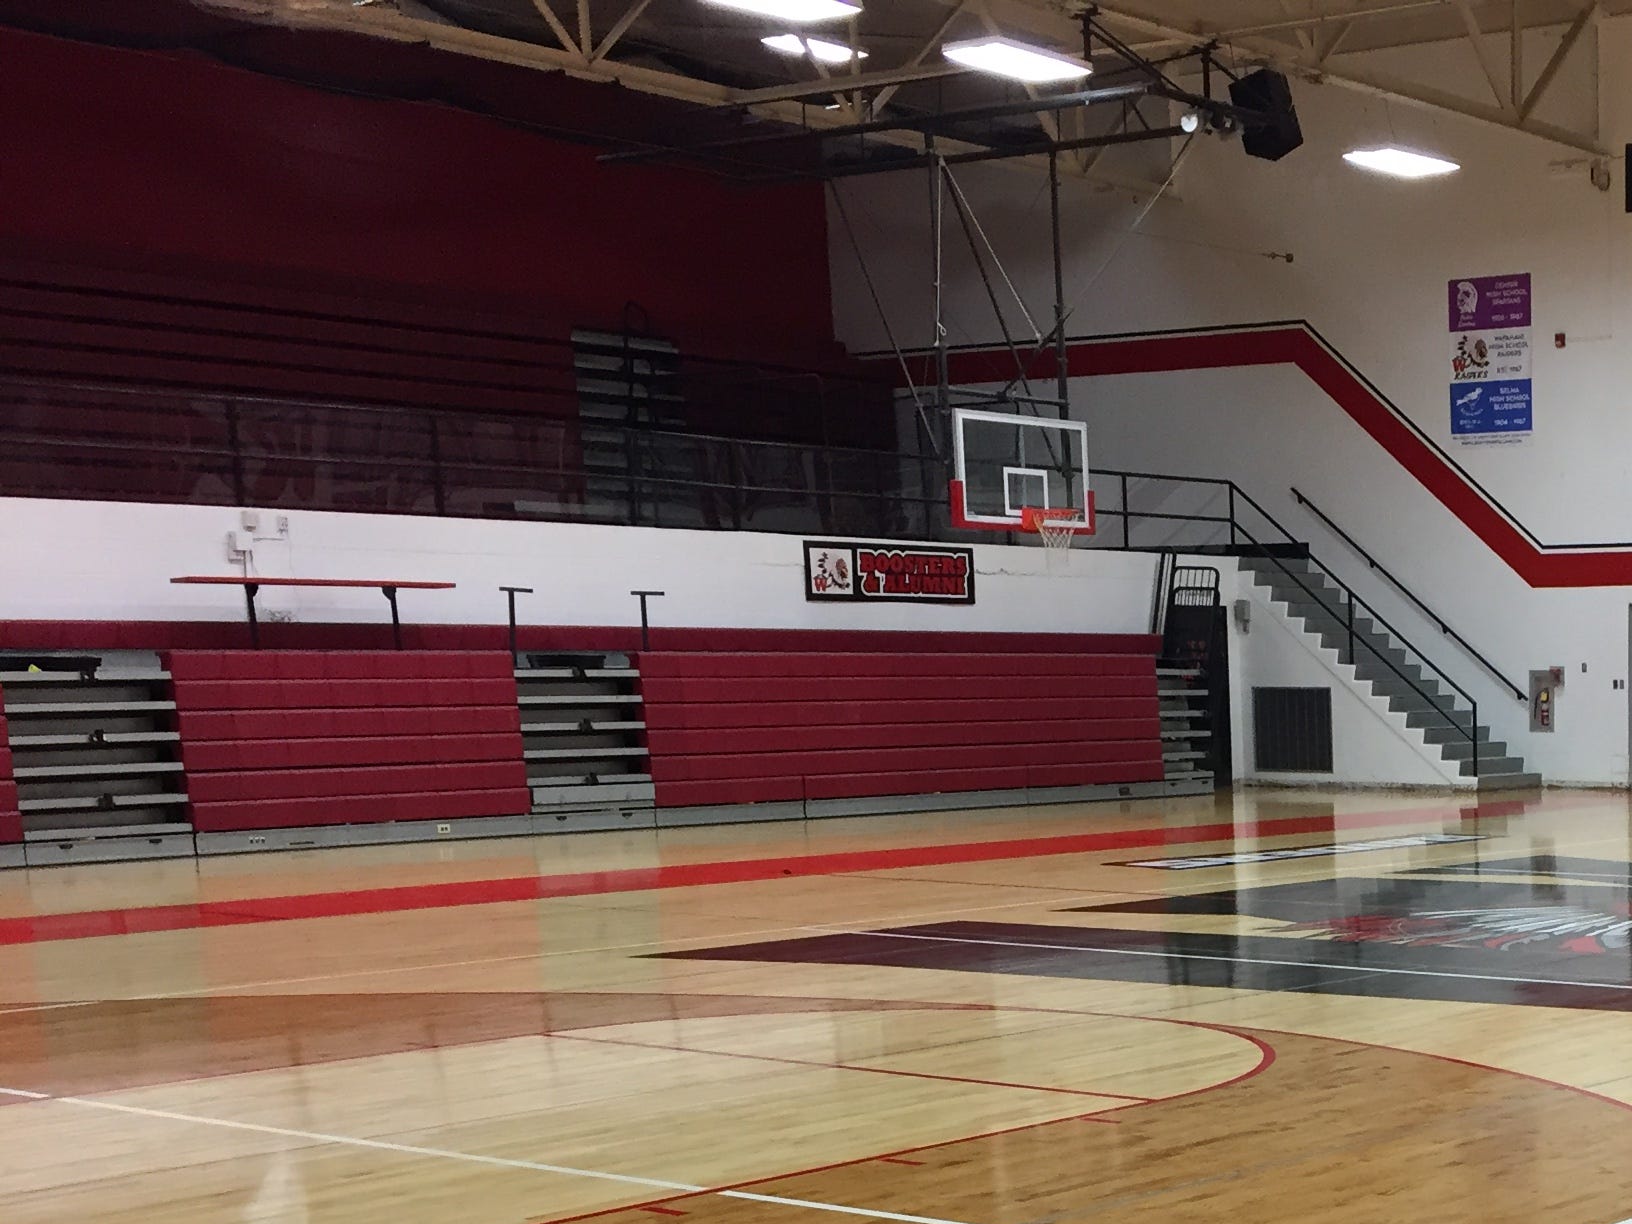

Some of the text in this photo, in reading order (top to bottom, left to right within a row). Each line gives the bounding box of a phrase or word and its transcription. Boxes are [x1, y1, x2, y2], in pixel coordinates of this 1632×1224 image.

[859, 551, 968, 576] BOOSTERS
[862, 573, 967, 595] & ALUMNI
